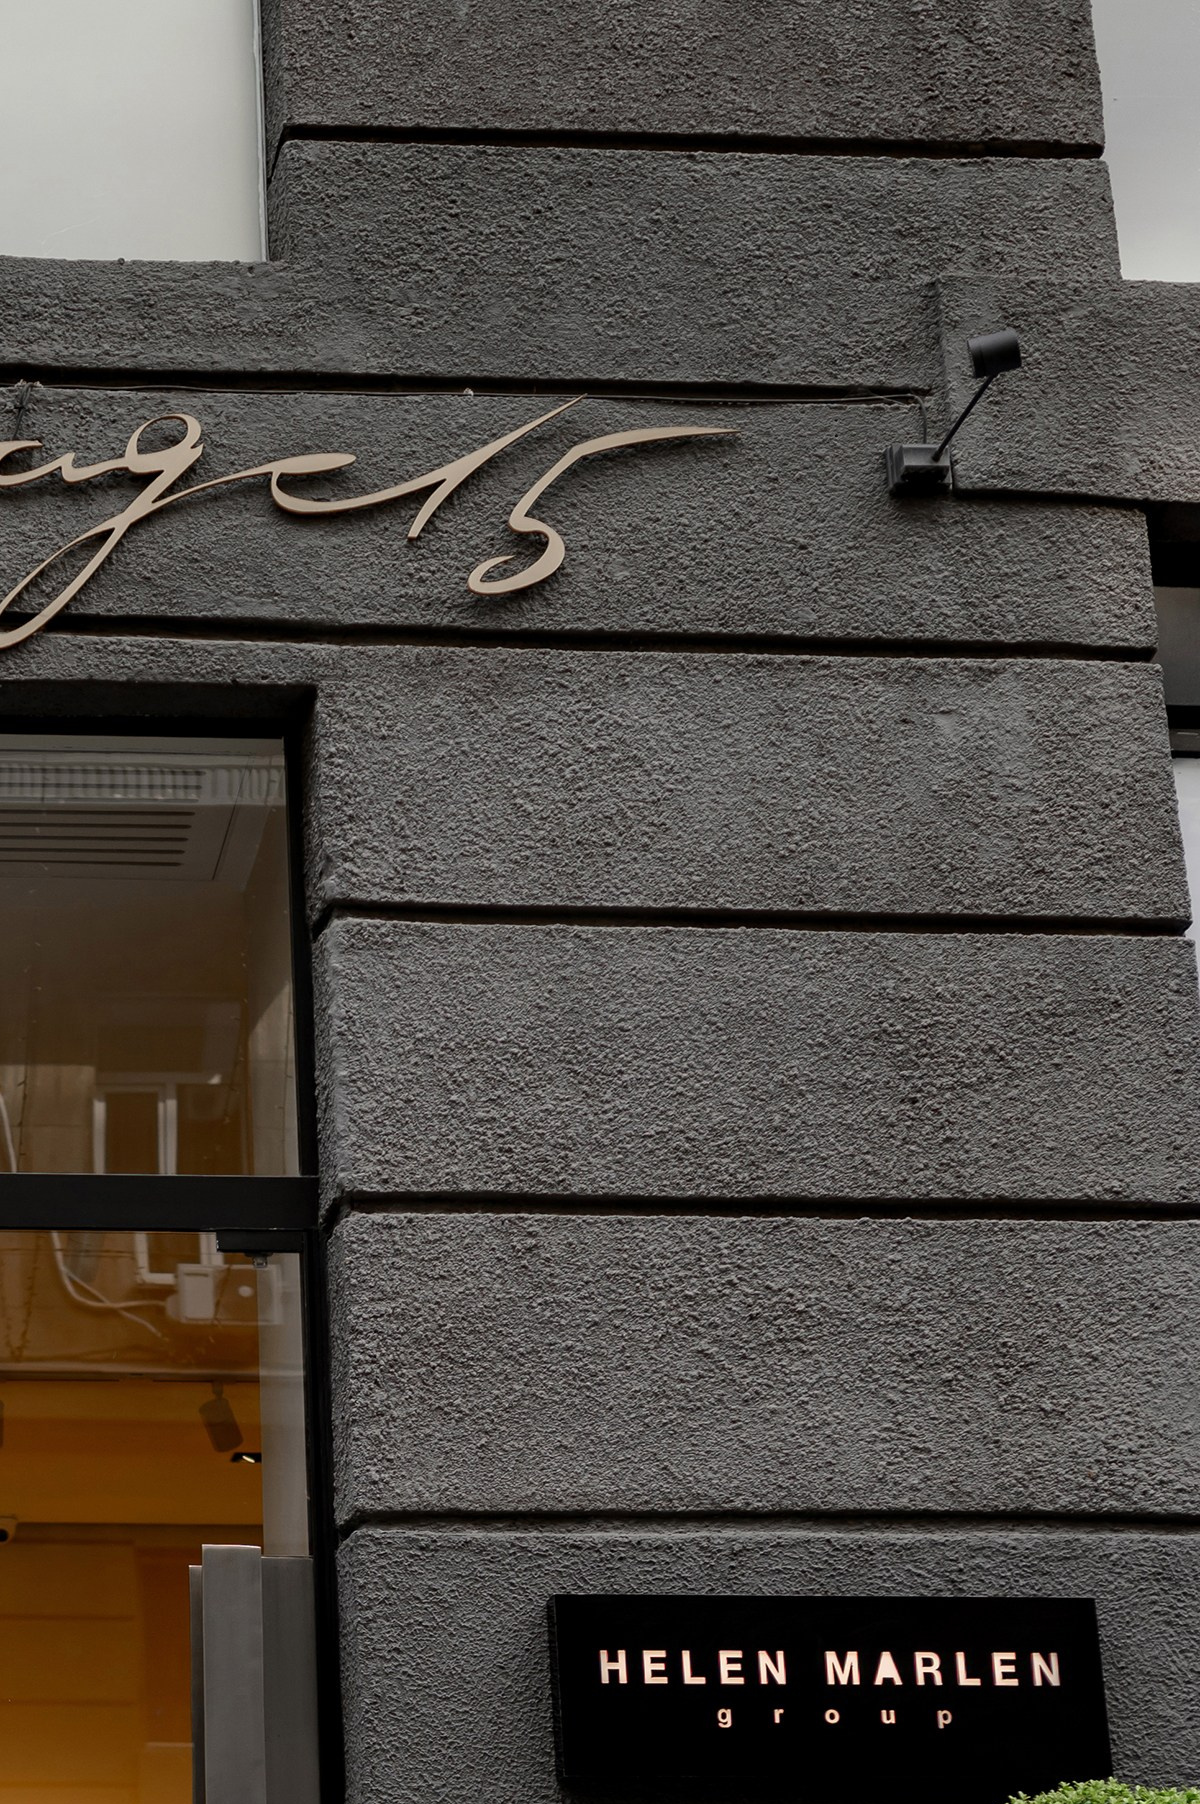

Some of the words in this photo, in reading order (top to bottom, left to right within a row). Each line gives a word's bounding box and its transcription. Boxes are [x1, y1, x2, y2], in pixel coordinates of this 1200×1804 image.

[599, 1649, 787, 1685] HELEN
[824, 1650, 1062, 1687] MARLEN
[717, 1708, 953, 1729] group
